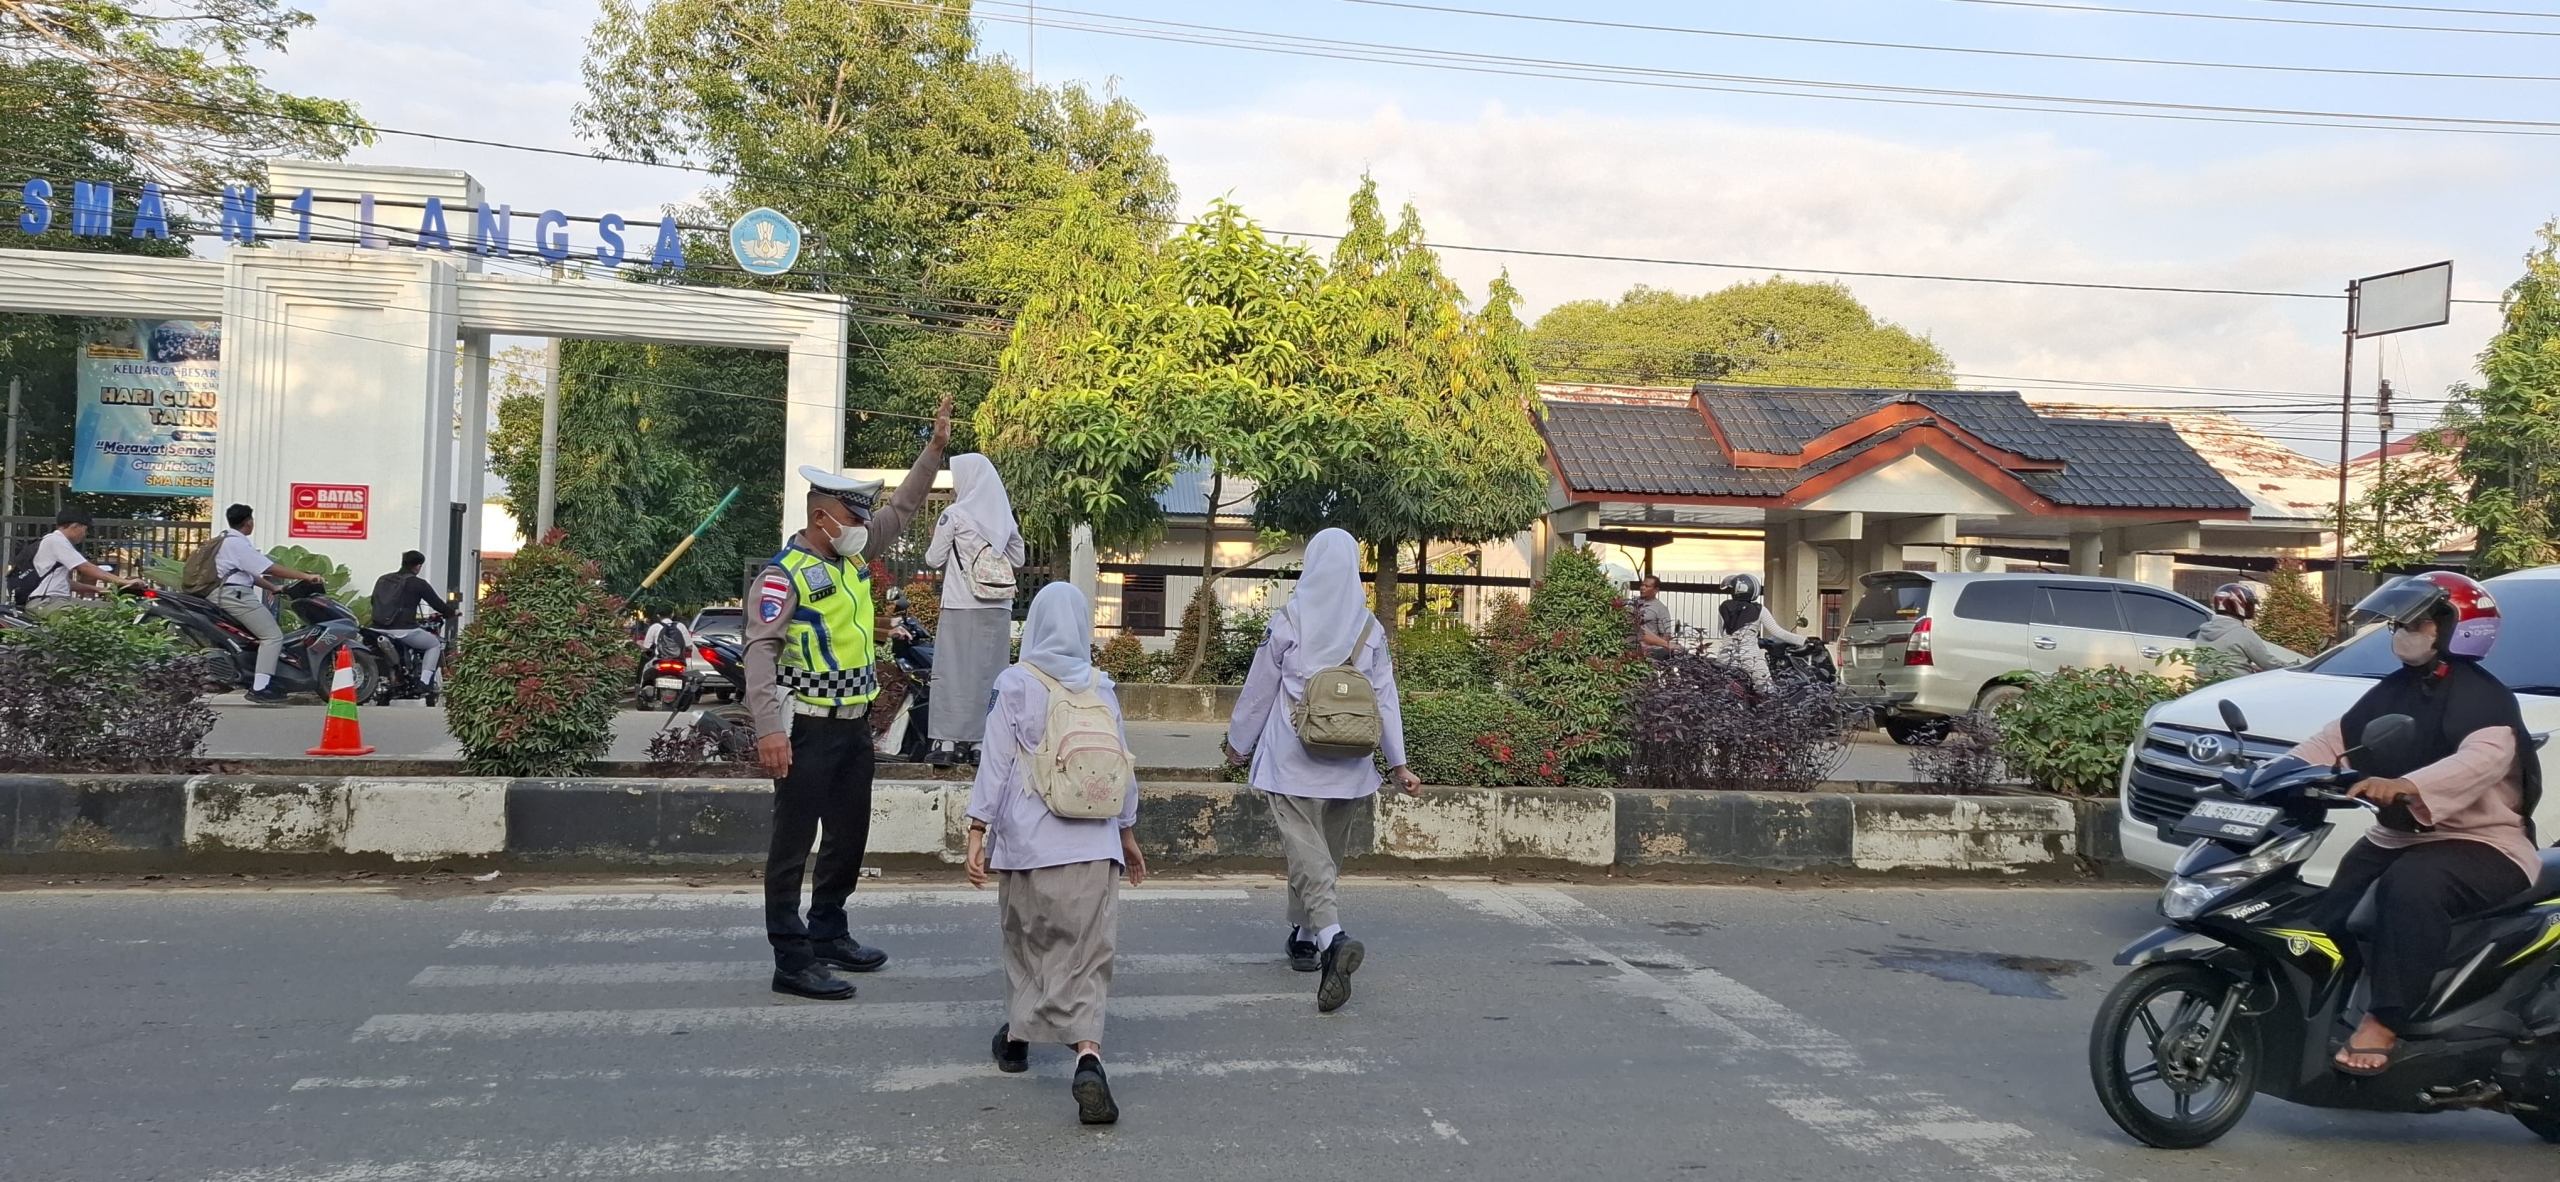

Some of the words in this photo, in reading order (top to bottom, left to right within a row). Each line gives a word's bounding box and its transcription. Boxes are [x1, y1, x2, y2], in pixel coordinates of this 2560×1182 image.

[20, 178, 169, 239] SMA
[360, 193, 686, 270] LANGSA
[113, 364, 176, 377] KELUARGA
[181, 367, 217, 378] BESAR
[101, 386, 154, 406] HARI
[159, 389, 217, 409] GURU
[149, 408, 217, 428] TAHUN
[132, 459, 162, 471] Guru
[164, 461, 204, 474] Hebat,
[145, 475, 173, 486] SMA
[317, 489, 364, 503] BATAS
[2194, 803, 2211, 816] BL
[2212, 806, 2243, 819] 5961
[2245, 810, 2271, 824] FAC
[2230, 901, 2271, 919] HONDA
